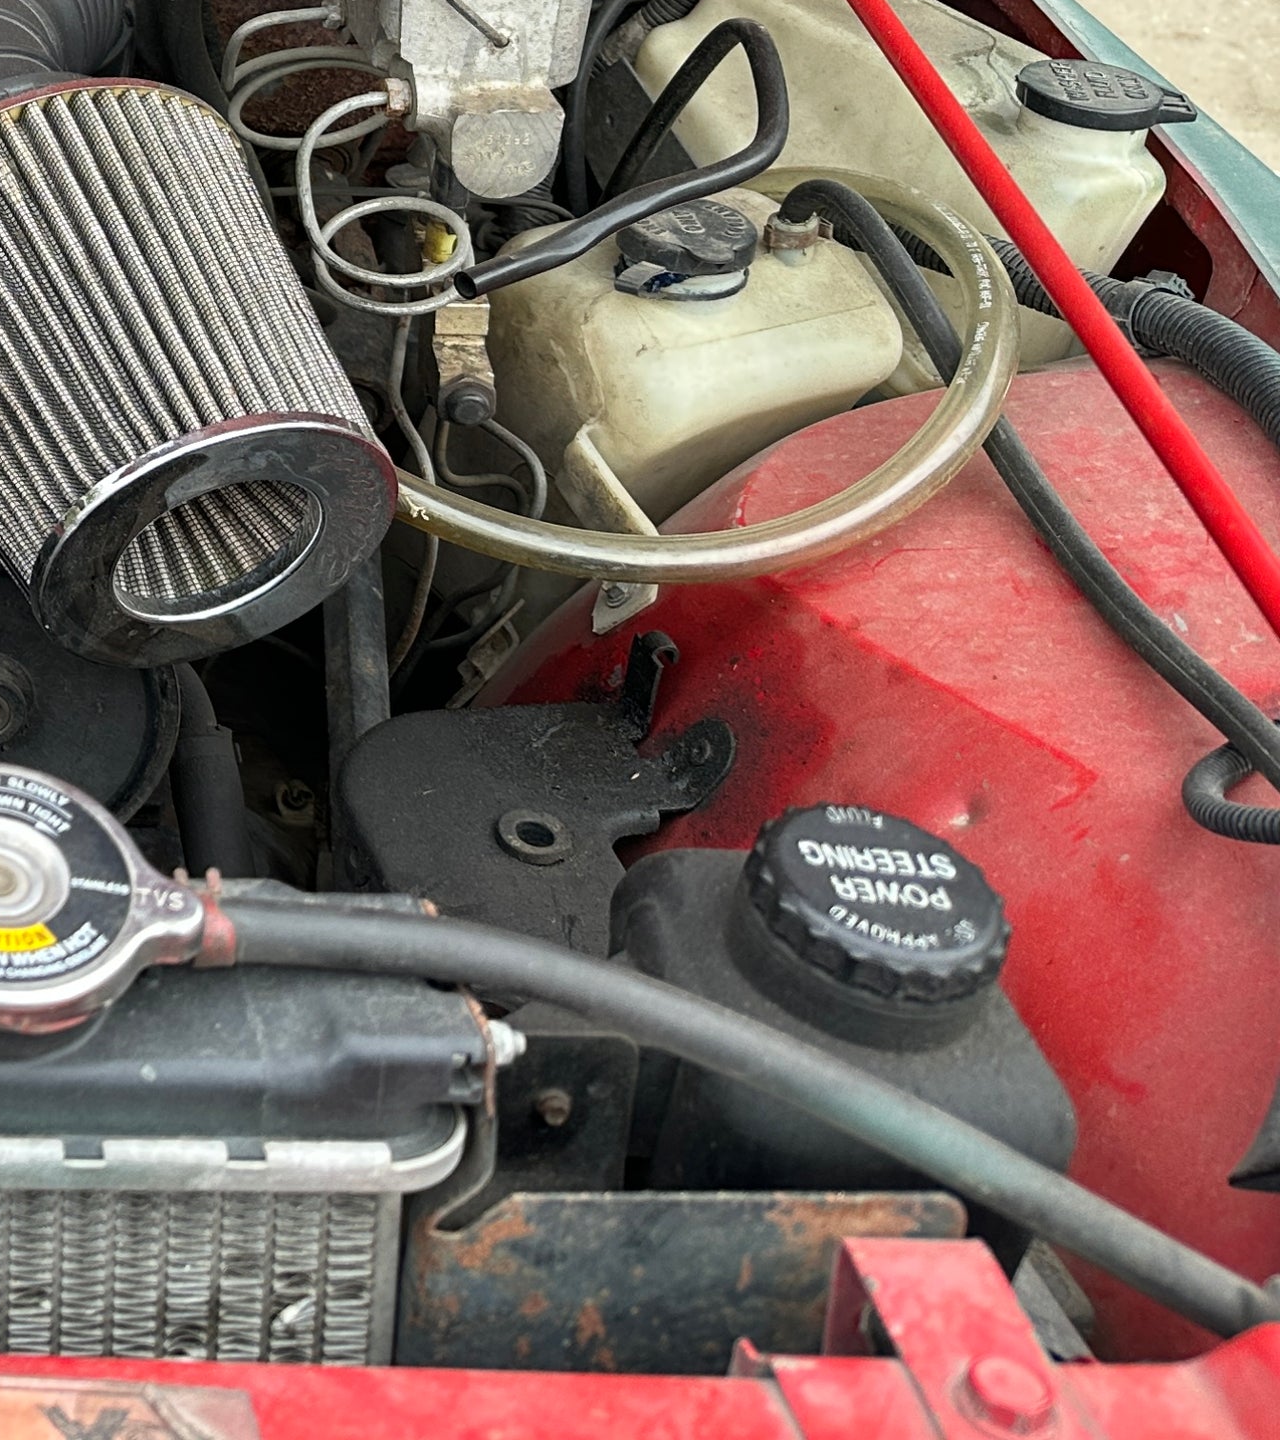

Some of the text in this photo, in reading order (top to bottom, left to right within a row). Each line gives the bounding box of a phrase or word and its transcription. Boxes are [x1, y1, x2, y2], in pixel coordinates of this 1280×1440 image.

[1083, 71, 1119, 99] FLUID
[7, 776, 70, 807] SLOWLY
[26, 801, 72, 833] TIGHT
[825, 806, 884, 831] FLUID
[797, 839, 958, 881] STEERING
[135, 886, 185, 912] TVS
[830, 874, 953, 911] POWER
[11, 942, 68, 968] WHEN
[62, 920, 99, 955] HOT
